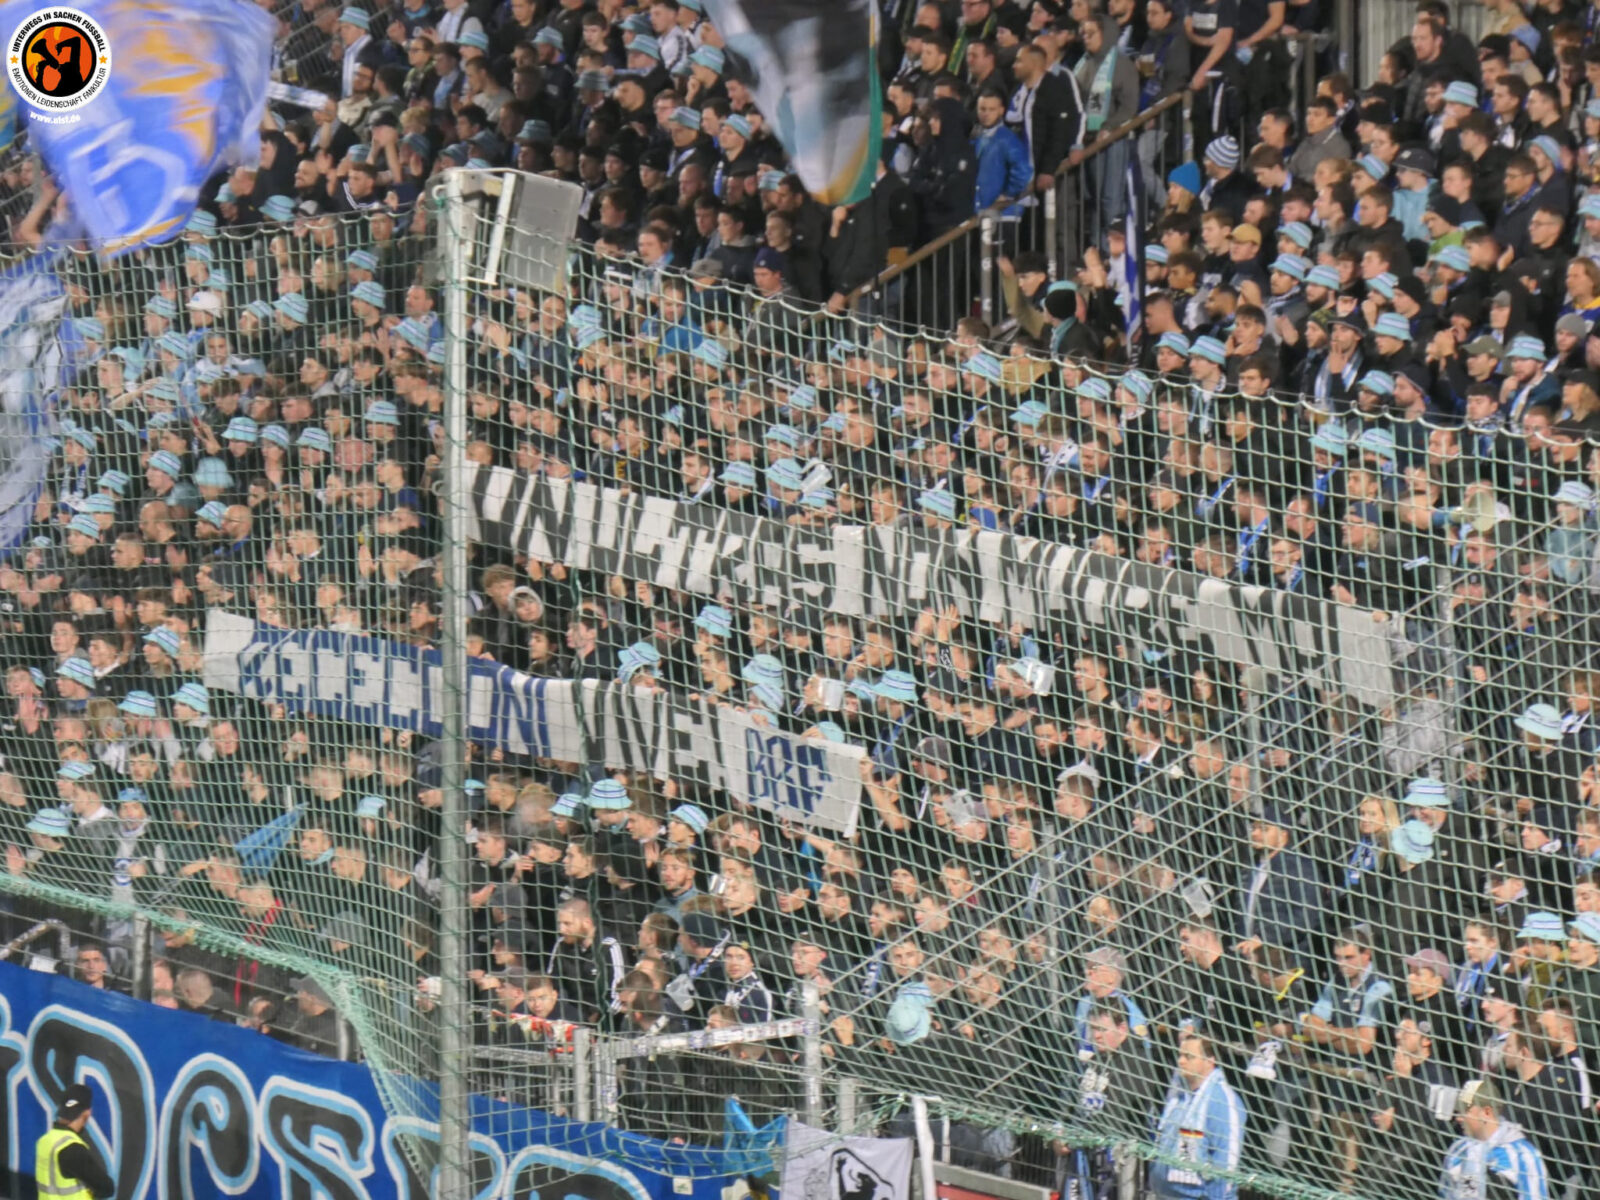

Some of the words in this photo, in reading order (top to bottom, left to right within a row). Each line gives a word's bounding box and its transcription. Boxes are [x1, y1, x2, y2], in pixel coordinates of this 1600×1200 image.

[472, 463, 576, 564] UN
[587, 486, 838, 614] ULTRAS
[863, 524, 984, 618] NON
[1229, 586, 1340, 690] MAI
